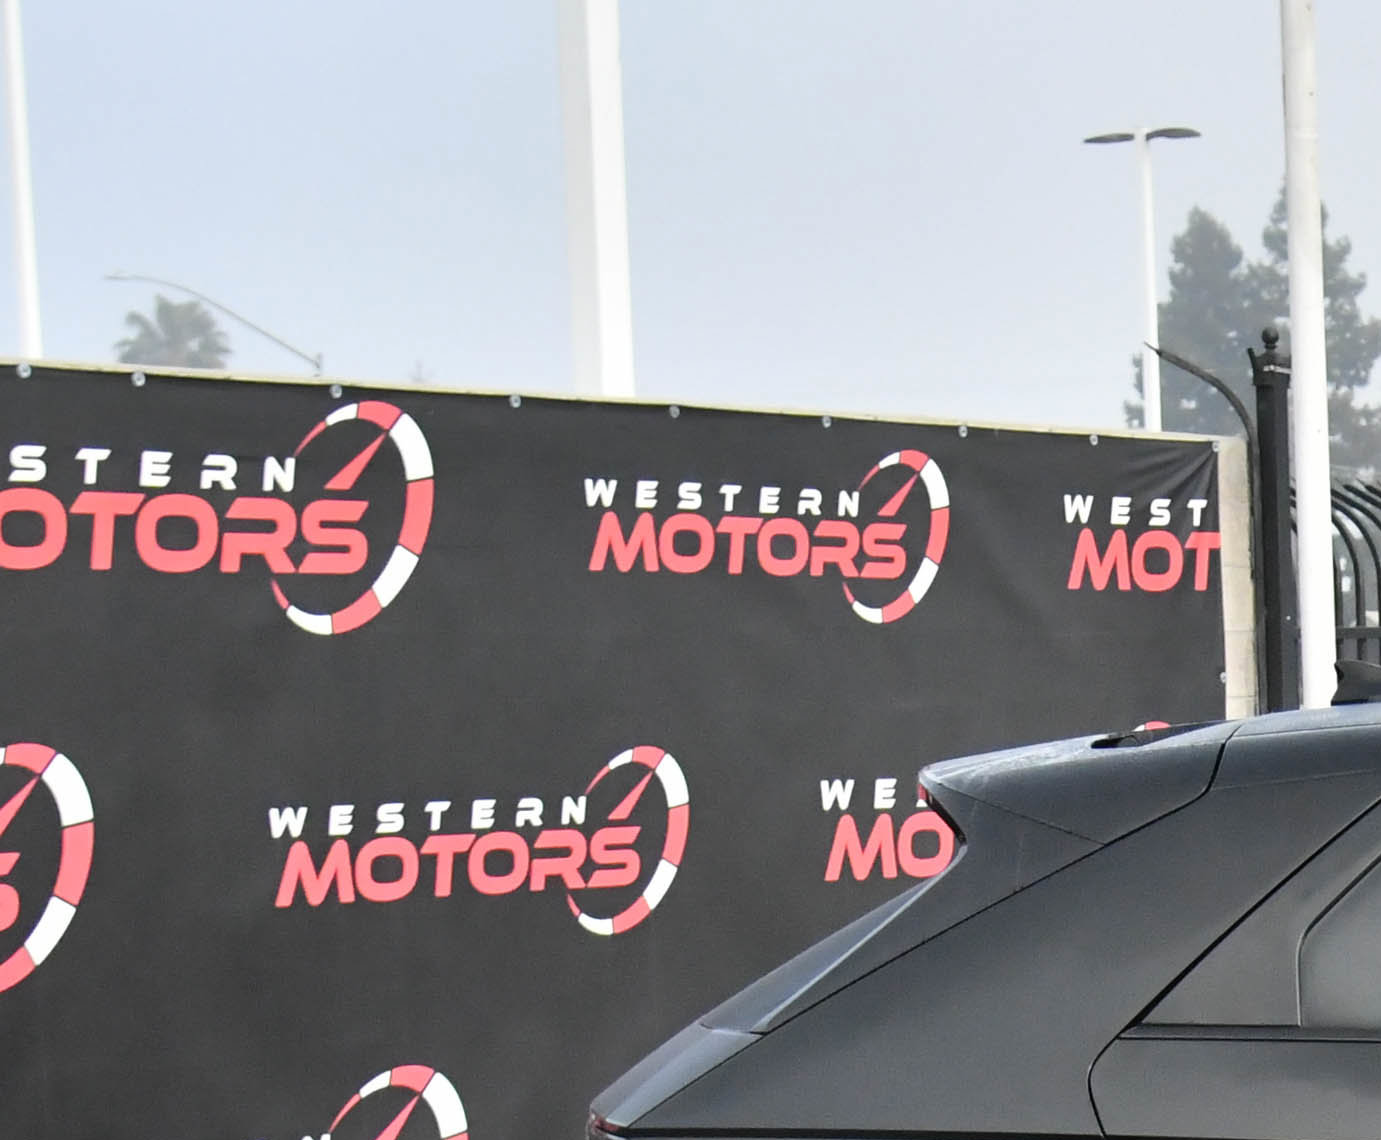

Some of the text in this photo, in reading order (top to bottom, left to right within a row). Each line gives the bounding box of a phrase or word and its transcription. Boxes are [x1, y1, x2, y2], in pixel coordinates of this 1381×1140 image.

[583, 477, 860, 518] WESTERN
[1063, 493, 1209, 528] WEST
[588, 511, 907, 580] MOTORS
[1067, 527, 1222, 593] MOT
[268, 795, 588, 839] WESTERN
[819, 778, 929, 811] WE
[274, 824, 642, 909] MOTORS
[824, 809, 955, 883] MO
